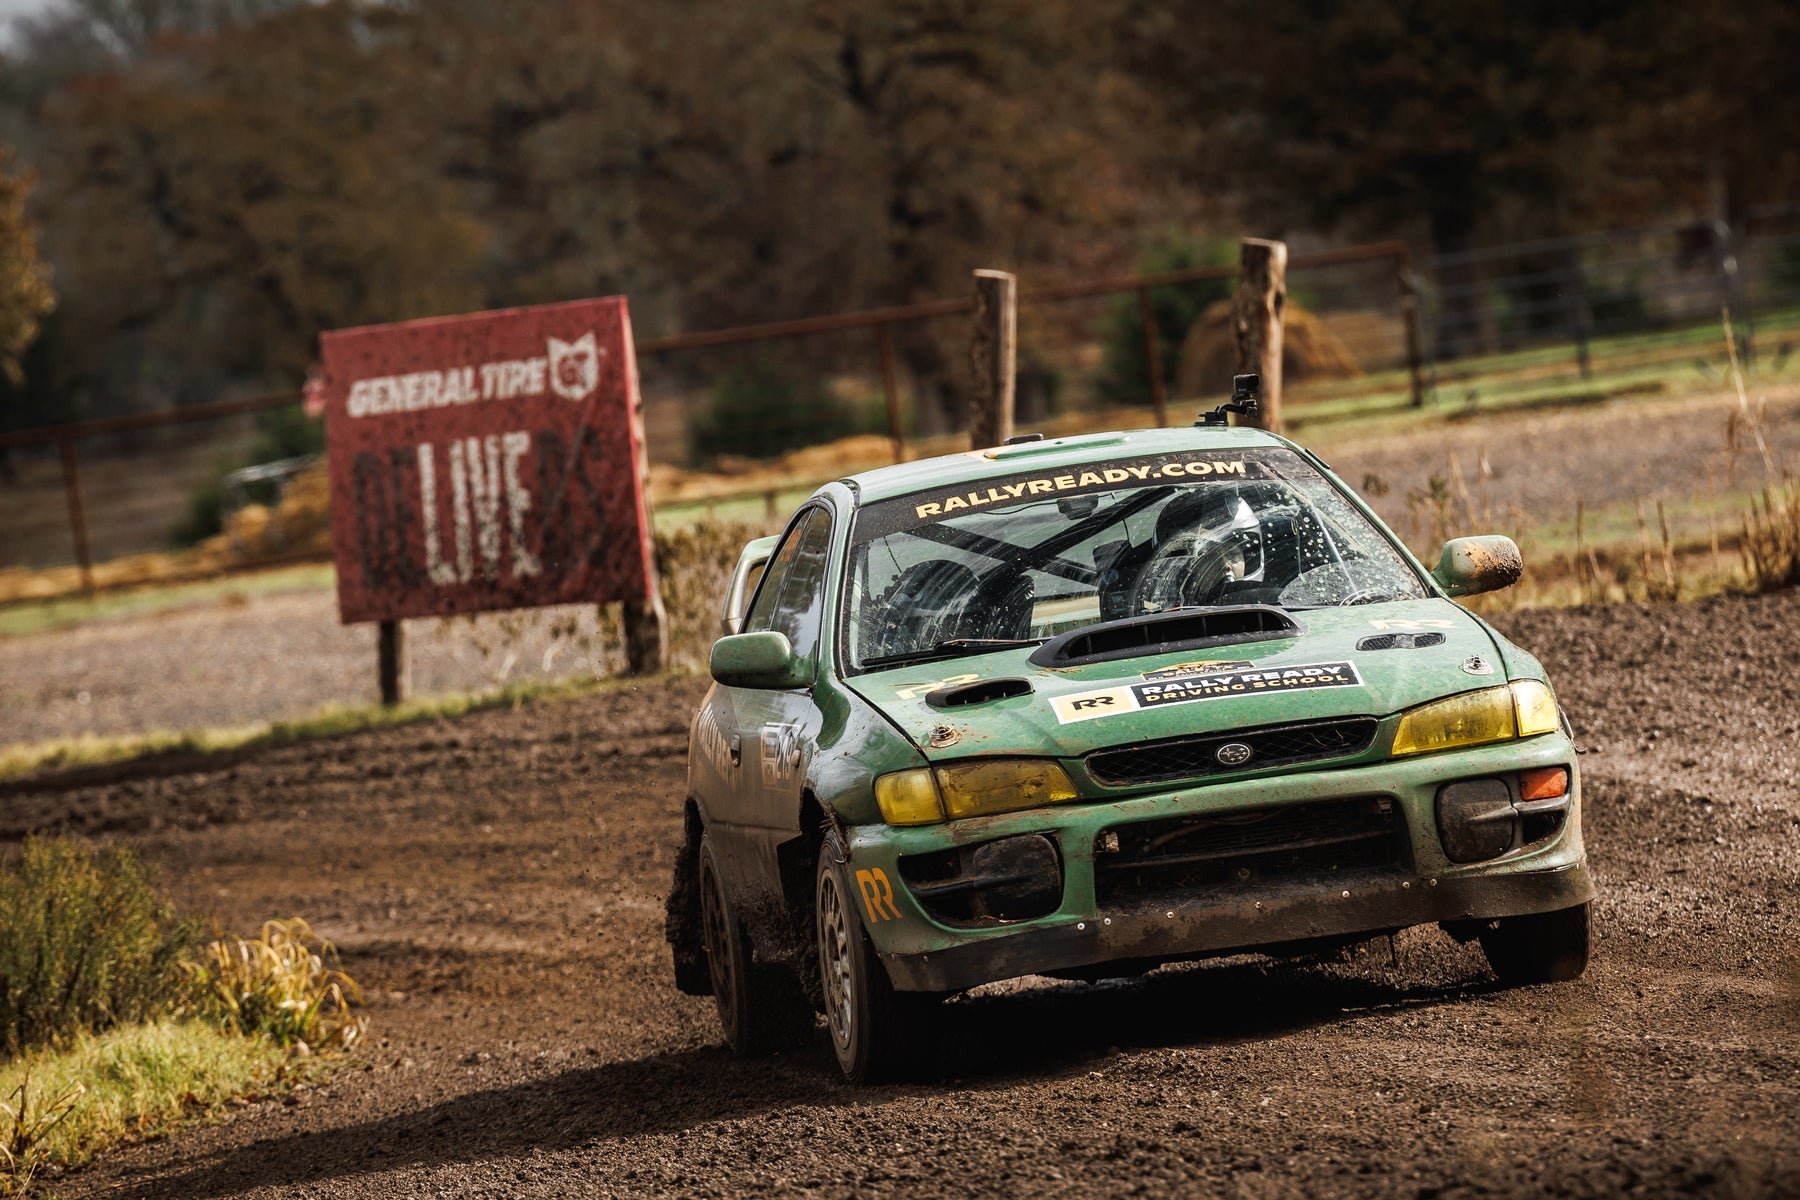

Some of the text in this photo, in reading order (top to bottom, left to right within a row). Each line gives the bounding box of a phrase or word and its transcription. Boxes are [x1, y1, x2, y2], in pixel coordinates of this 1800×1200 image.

[347, 356, 549, 418] GENERAL TIRE
[915, 461, 1247, 519] RALLYREADY.COM
[1141, 674, 1239, 696] RALLY
[1241, 665, 1343, 683] READY
[1145, 673, 1350, 703] DRIVING SCHOOL
[1071, 695, 1115, 711] RR
[855, 867, 904, 924] RR
